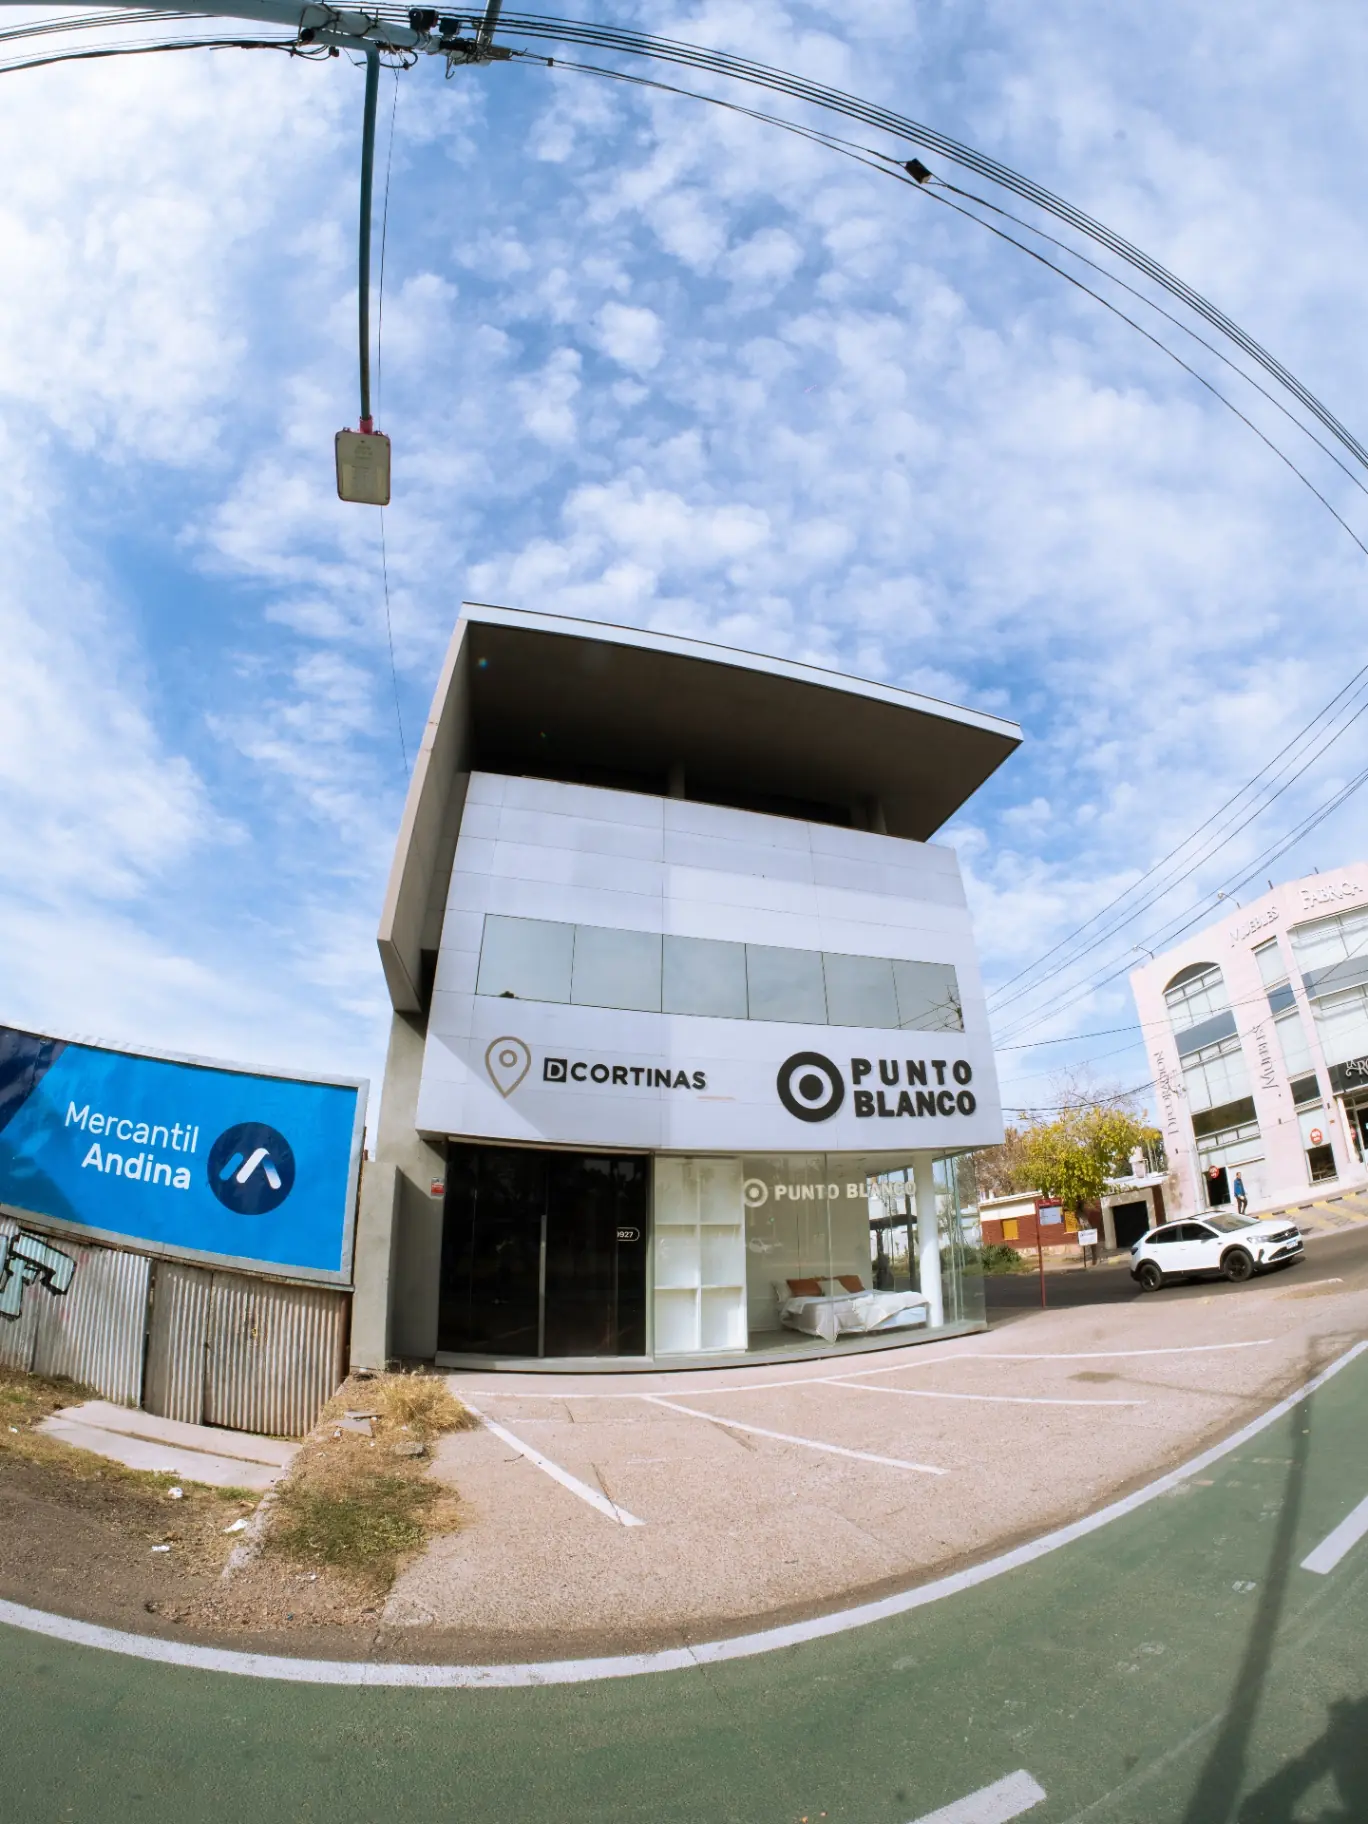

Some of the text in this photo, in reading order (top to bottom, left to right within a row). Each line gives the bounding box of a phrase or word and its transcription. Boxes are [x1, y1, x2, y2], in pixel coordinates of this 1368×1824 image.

[851, 1058, 972, 1086] PUNTO
[854, 1090, 976, 1117] BLANCO
[64, 1100, 199, 1153] Mercantil
[81, 1142, 191, 1190] Andina
[774, 1183, 840, 1200] PUNTO
[846, 1181, 917, 1199] BLANCO
